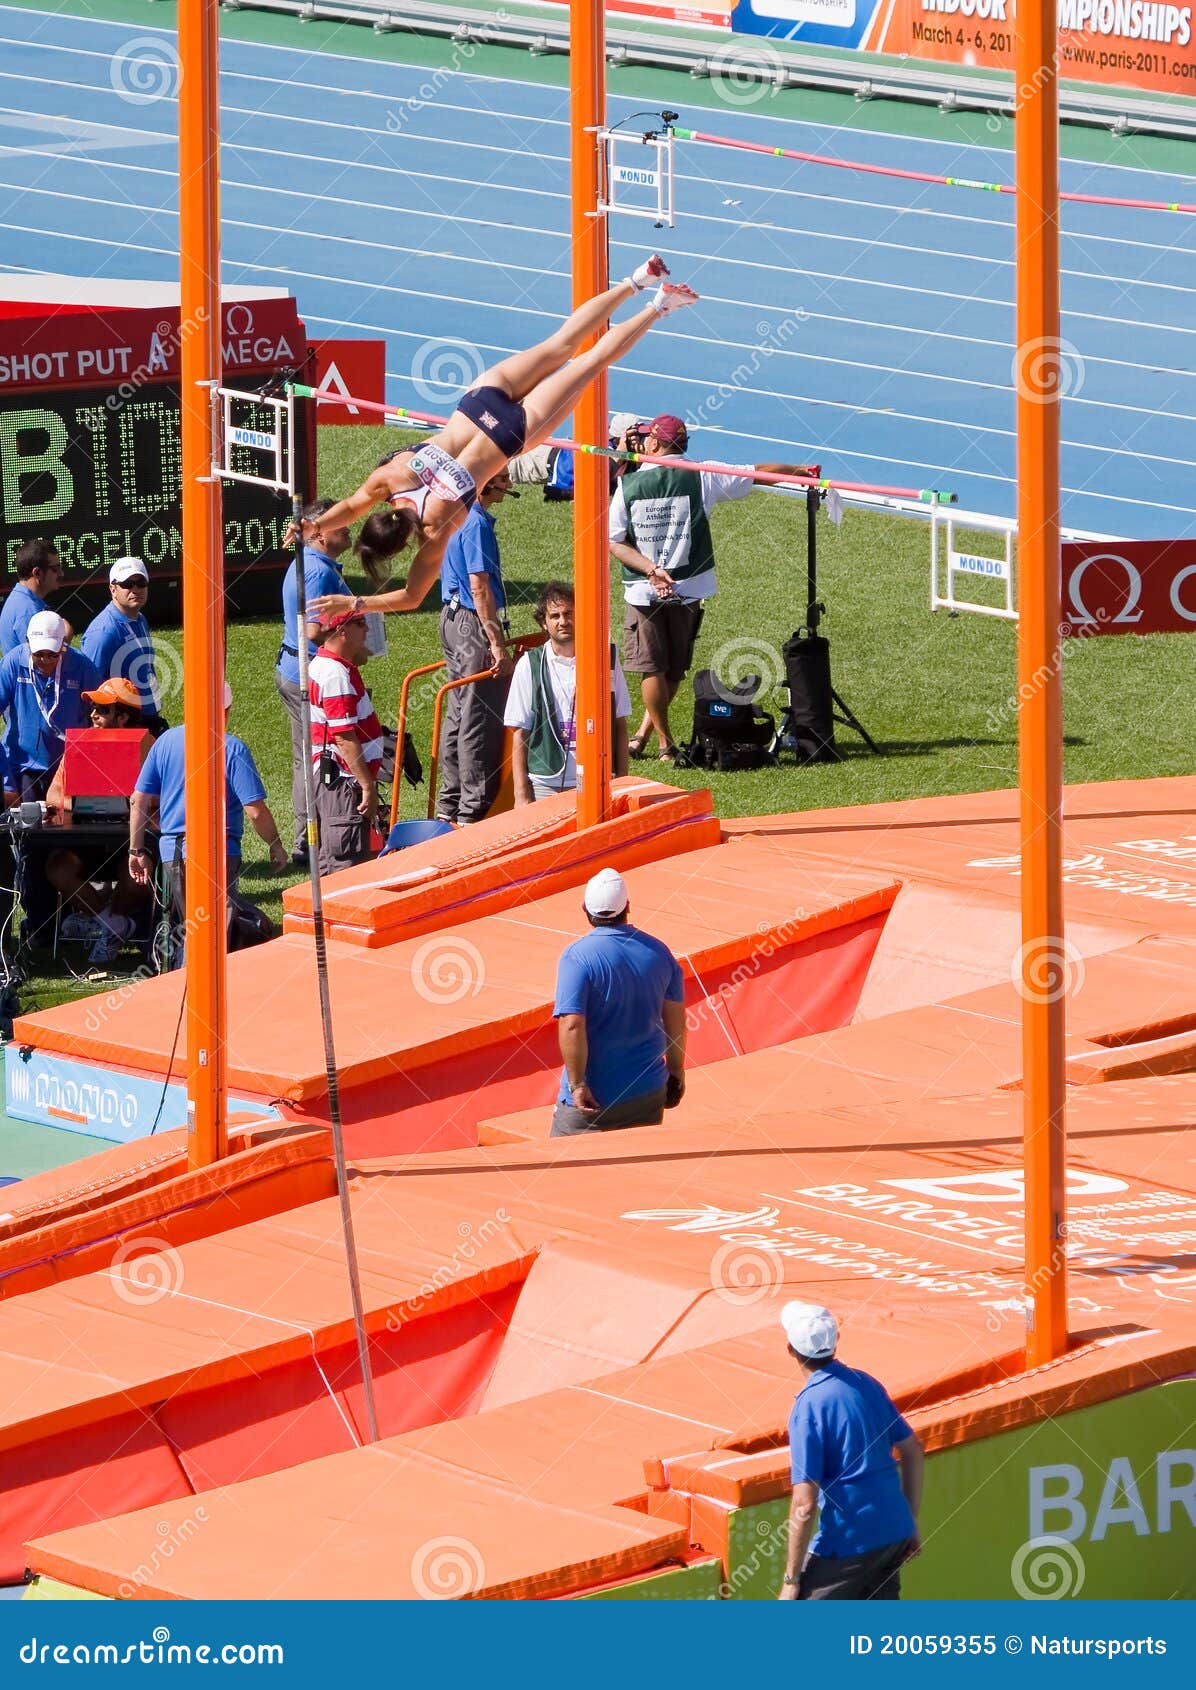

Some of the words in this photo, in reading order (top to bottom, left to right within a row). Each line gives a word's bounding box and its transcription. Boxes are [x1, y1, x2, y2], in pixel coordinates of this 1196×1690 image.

[912, 21, 952, 45] March
[955, 28, 965, 46] 4
[990, 31, 1017, 53] 201
[619, 169, 655, 185] MONDO
[0, 353, 68, 382] SHOT
[77, 347, 133, 377] PUT
[147, 331, 169, 374] A
[221, 335, 295, 367] MEGA
[234, 429, 272, 448] MONDO
[645, 505, 677, 513] European
[6, 525, 183, 573] BRCELON
[637, 534, 674, 543] ARCELONA
[959, 555, 1003, 575] MONDO
[1028, 1448, 1196, 1549] BAR
